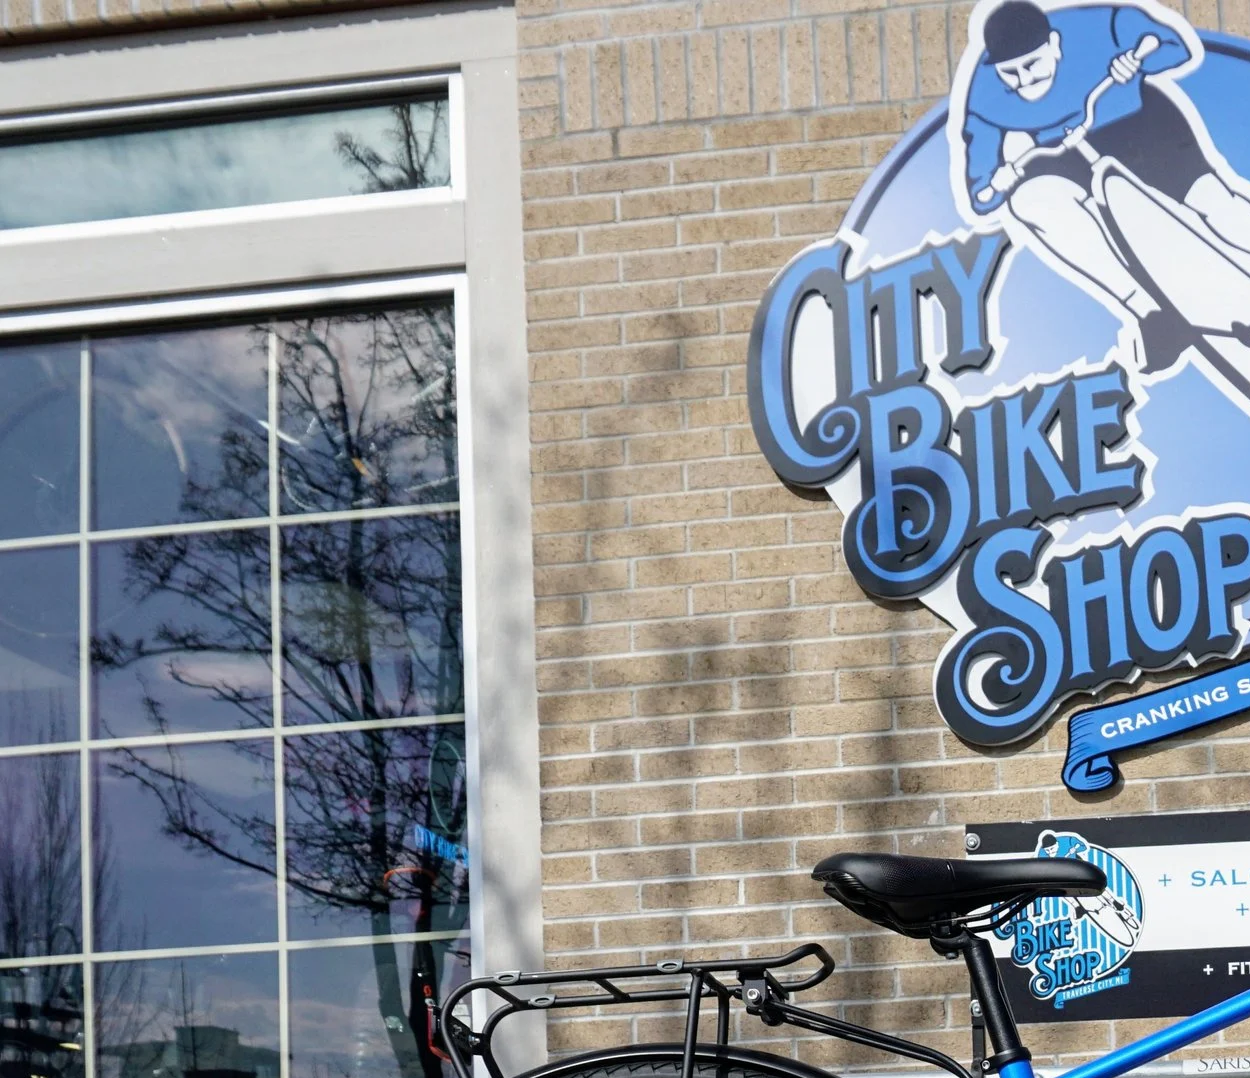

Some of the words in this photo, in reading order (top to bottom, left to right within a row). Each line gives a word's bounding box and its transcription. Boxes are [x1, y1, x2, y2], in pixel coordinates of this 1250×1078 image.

[1100, 686, 1229, 738] CRANKING
[1011, 917, 1076, 965] BIKE
[1031, 951, 1101, 996] SHOP
[1062, 983, 1096, 1000] TRAVERSE
